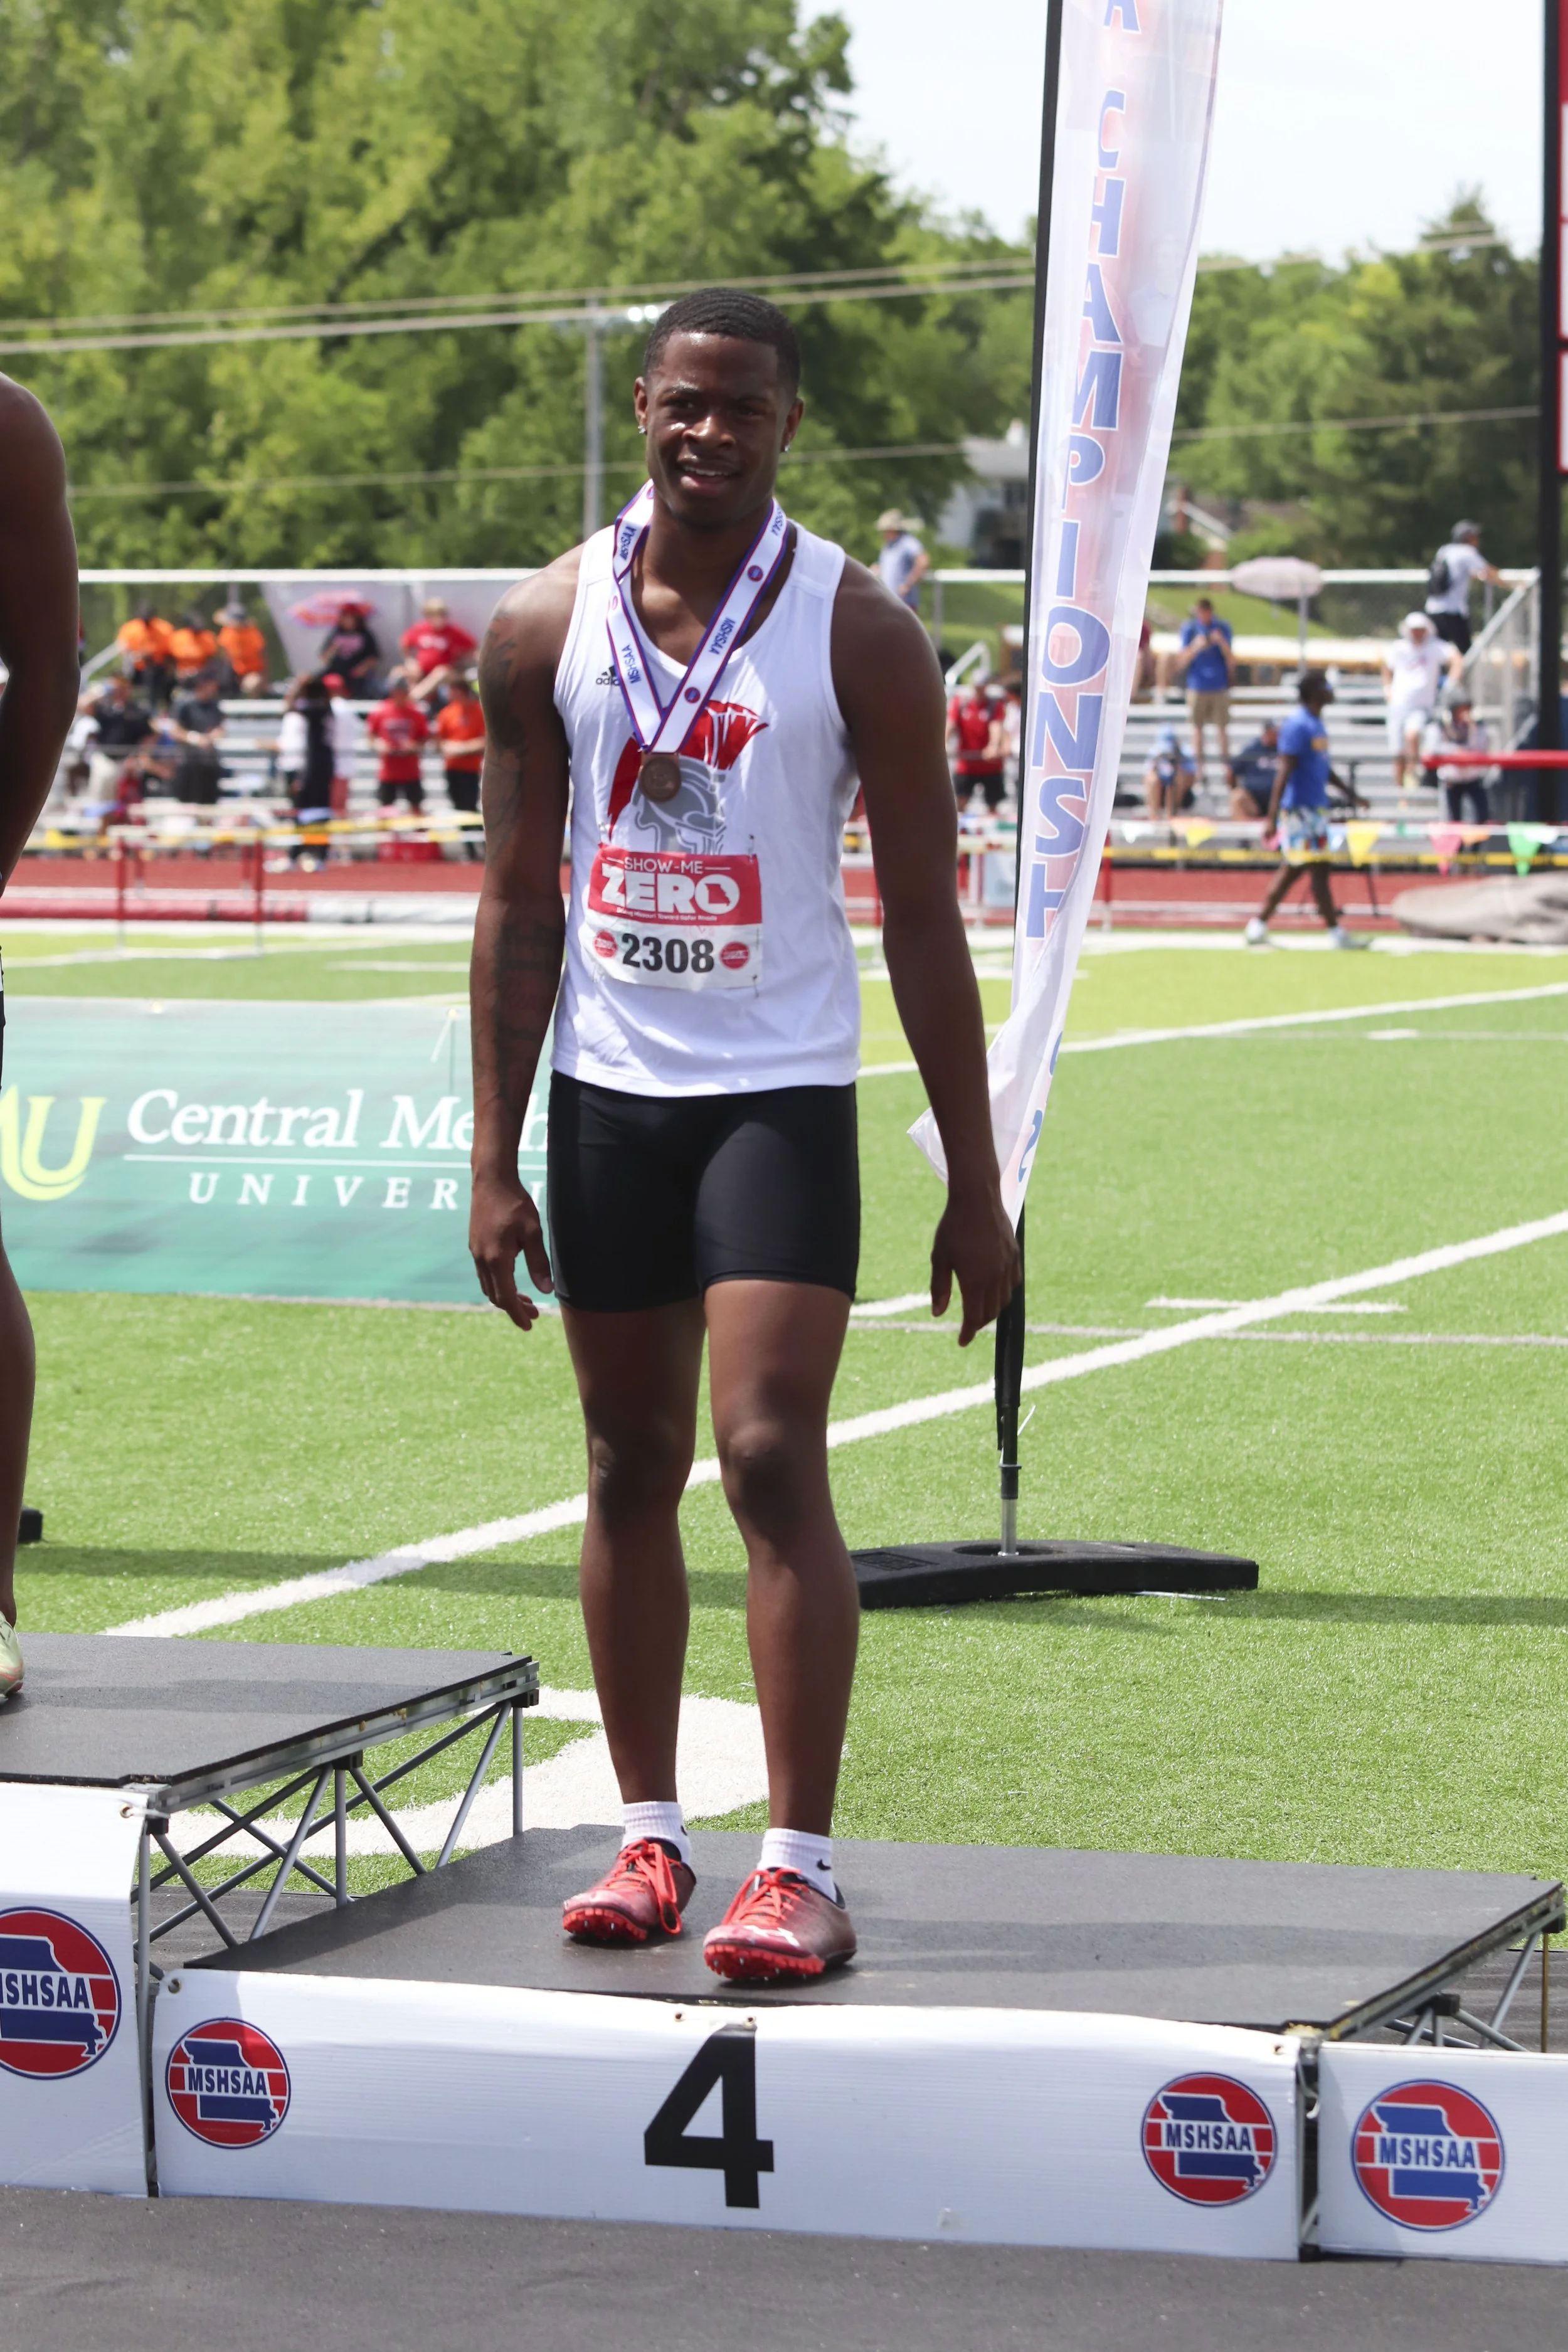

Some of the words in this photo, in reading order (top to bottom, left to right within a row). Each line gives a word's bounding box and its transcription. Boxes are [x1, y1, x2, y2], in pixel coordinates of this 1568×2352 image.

[601, 862, 739, 915] ZERO
[622, 933, 714, 973] 2308
[127, 1088, 363, 1148] Central
[0, 1972, 90, 2009] SHSAA
[189, 2067, 267, 2095] MSHSAA
[644, 2023, 775, 2209] 4
[1166, 2122, 1251, 2151] MSHSAA
[1380, 2136, 1475, 2169] MSHSAA
